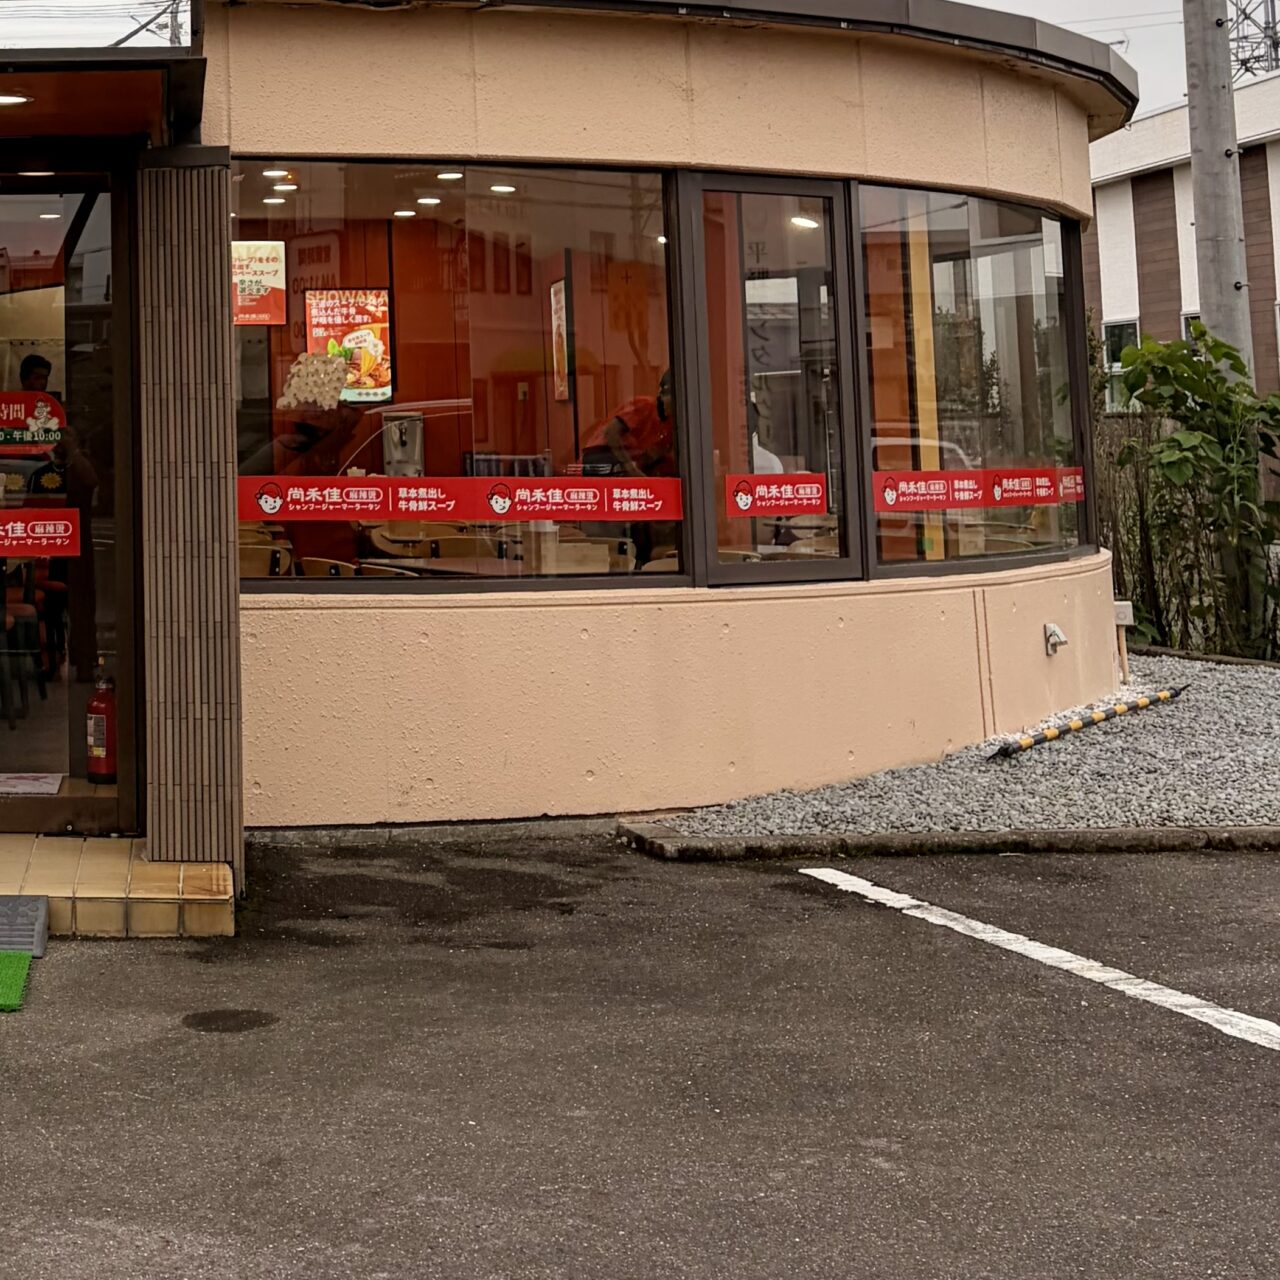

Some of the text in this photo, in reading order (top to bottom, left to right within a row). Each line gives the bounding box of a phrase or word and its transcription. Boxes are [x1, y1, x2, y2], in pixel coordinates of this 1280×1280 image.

[286, 487, 343, 502] 尚禾佳
[514, 488, 564, 502] 尚禾佳
[755, 484, 794, 498] 尚禾佳
